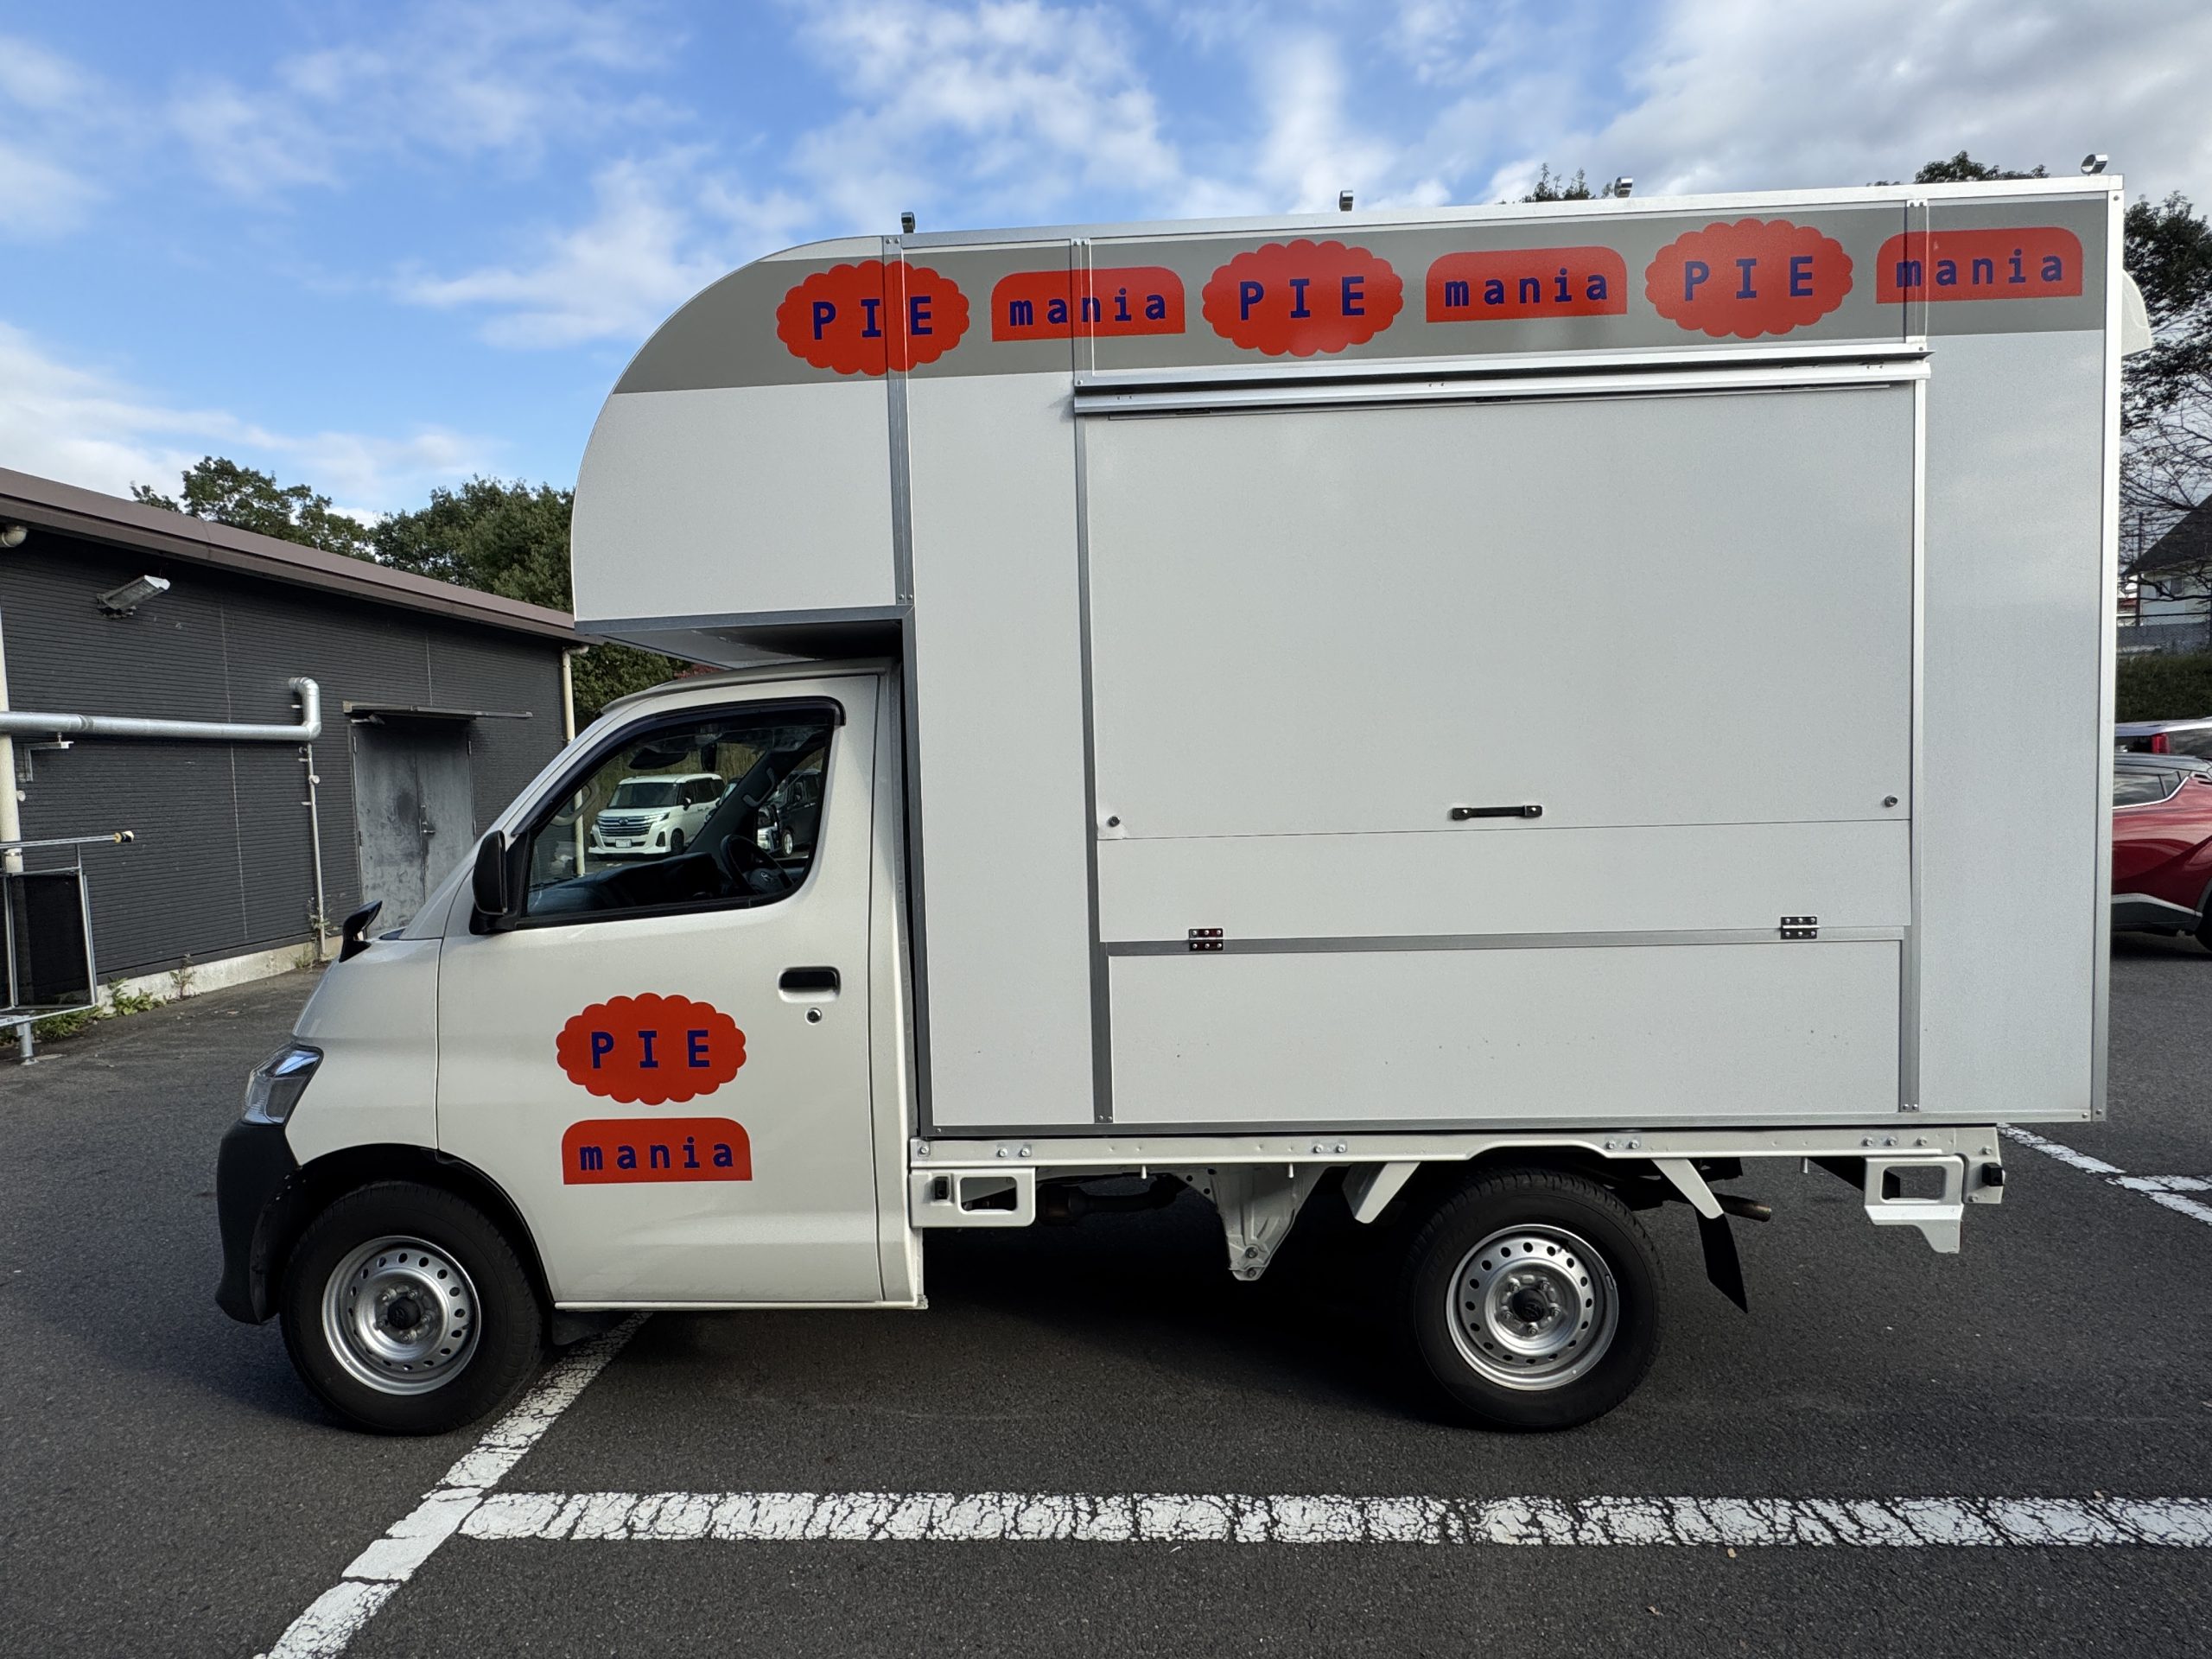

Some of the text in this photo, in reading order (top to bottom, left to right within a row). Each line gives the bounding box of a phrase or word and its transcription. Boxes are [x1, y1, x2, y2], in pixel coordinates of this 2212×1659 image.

[812, 247, 2062, 340] PIE mania PIE mania PIE mania
[591, 1030, 709, 1069] PIE
[580, 1136, 733, 1170] mania
